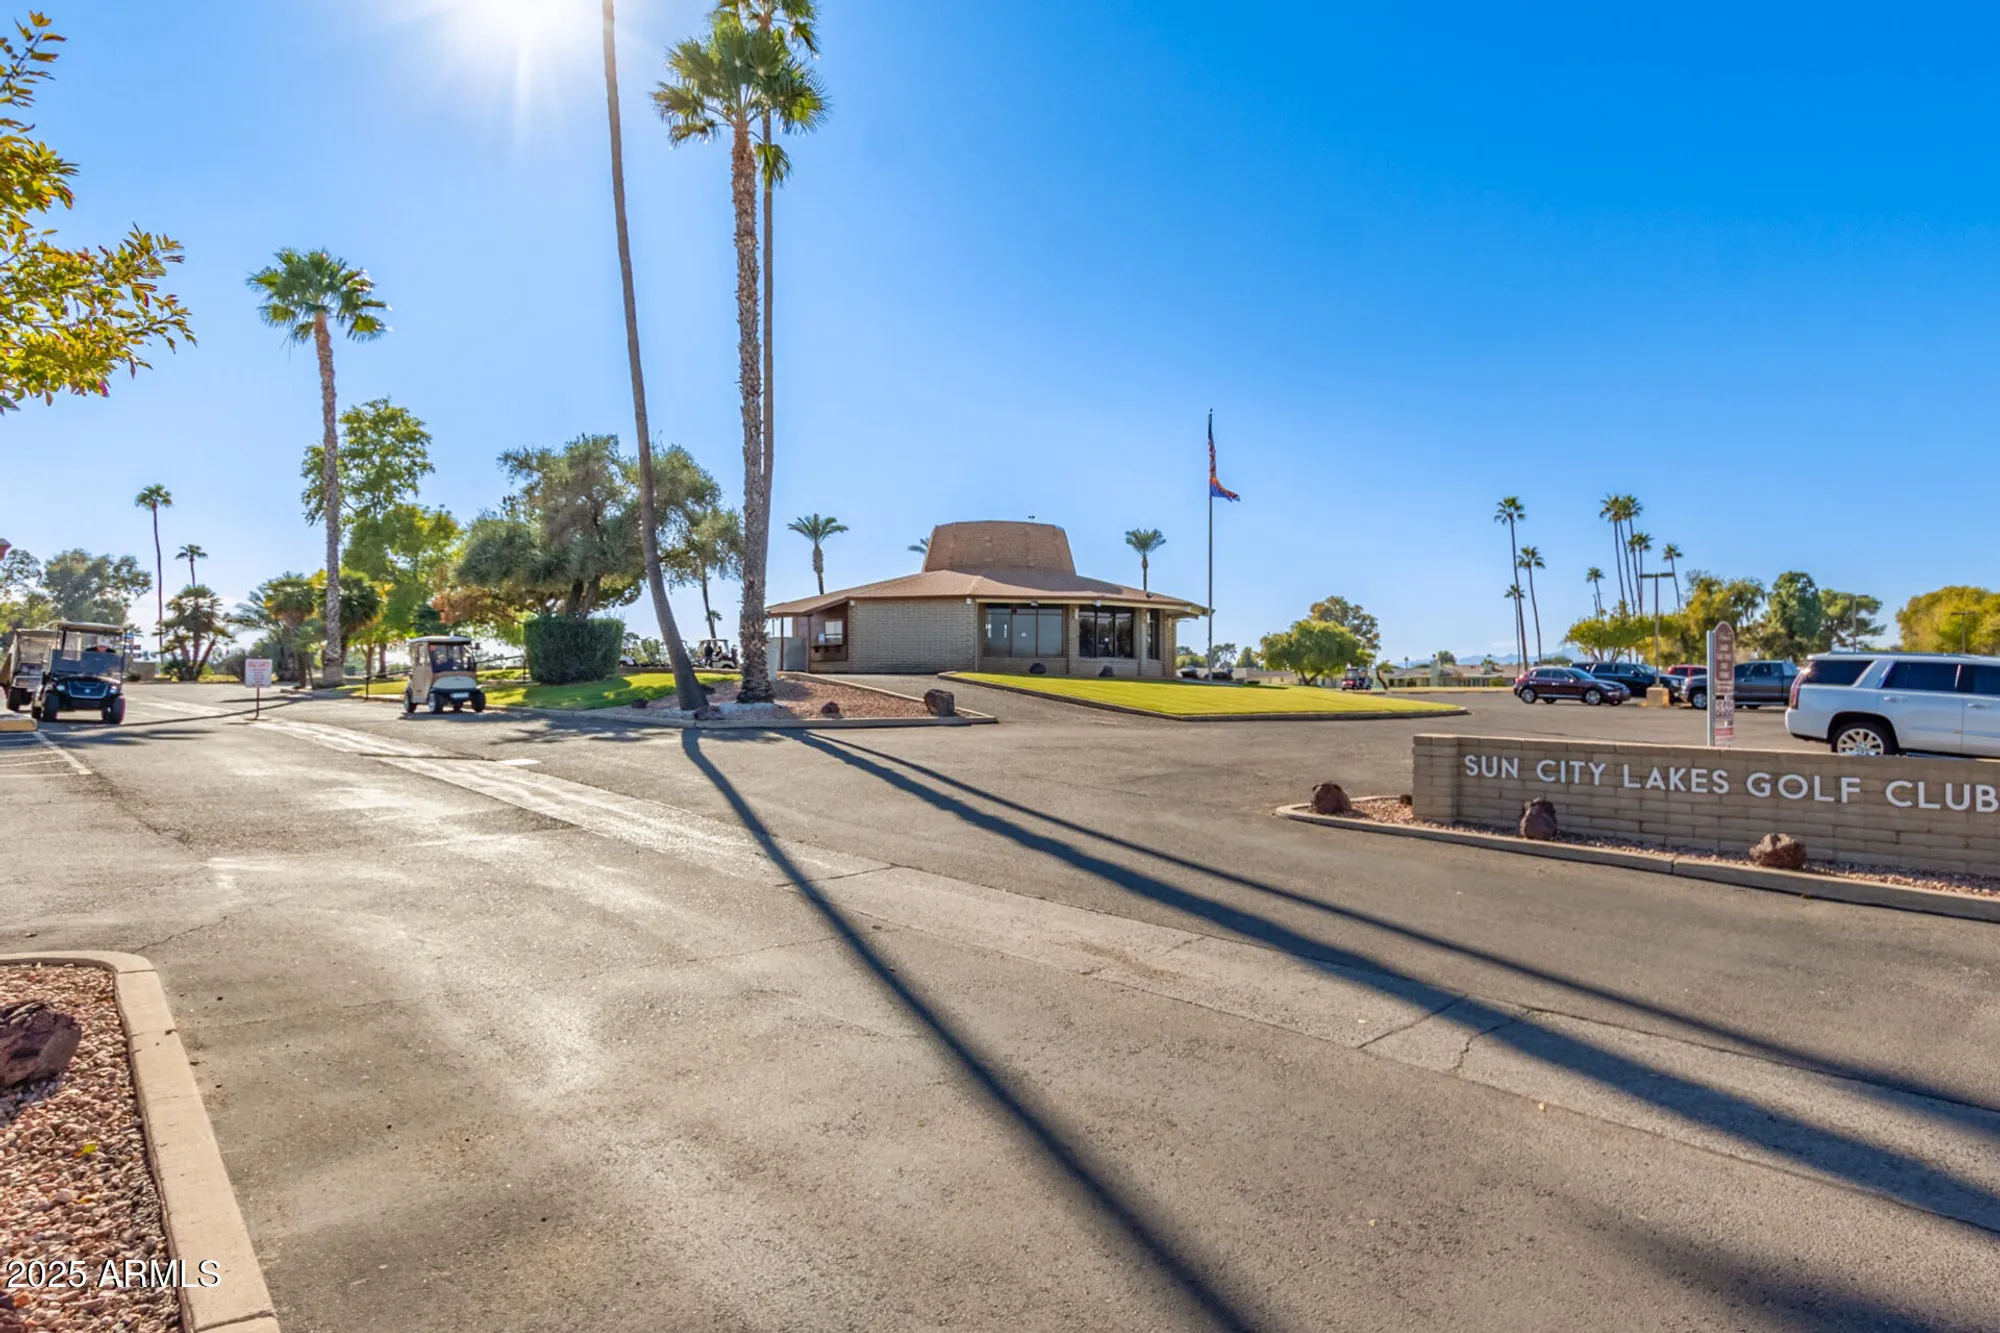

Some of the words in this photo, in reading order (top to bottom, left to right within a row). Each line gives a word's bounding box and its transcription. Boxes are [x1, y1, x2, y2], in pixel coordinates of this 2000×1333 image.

[1464, 754, 1519, 779] SUN
[1536, 759, 1606, 786] CITY
[1623, 765, 1730, 793] LAKES
[1746, 772, 1861, 803] GOLF
[1885, 780, 1999, 813] CLUB
